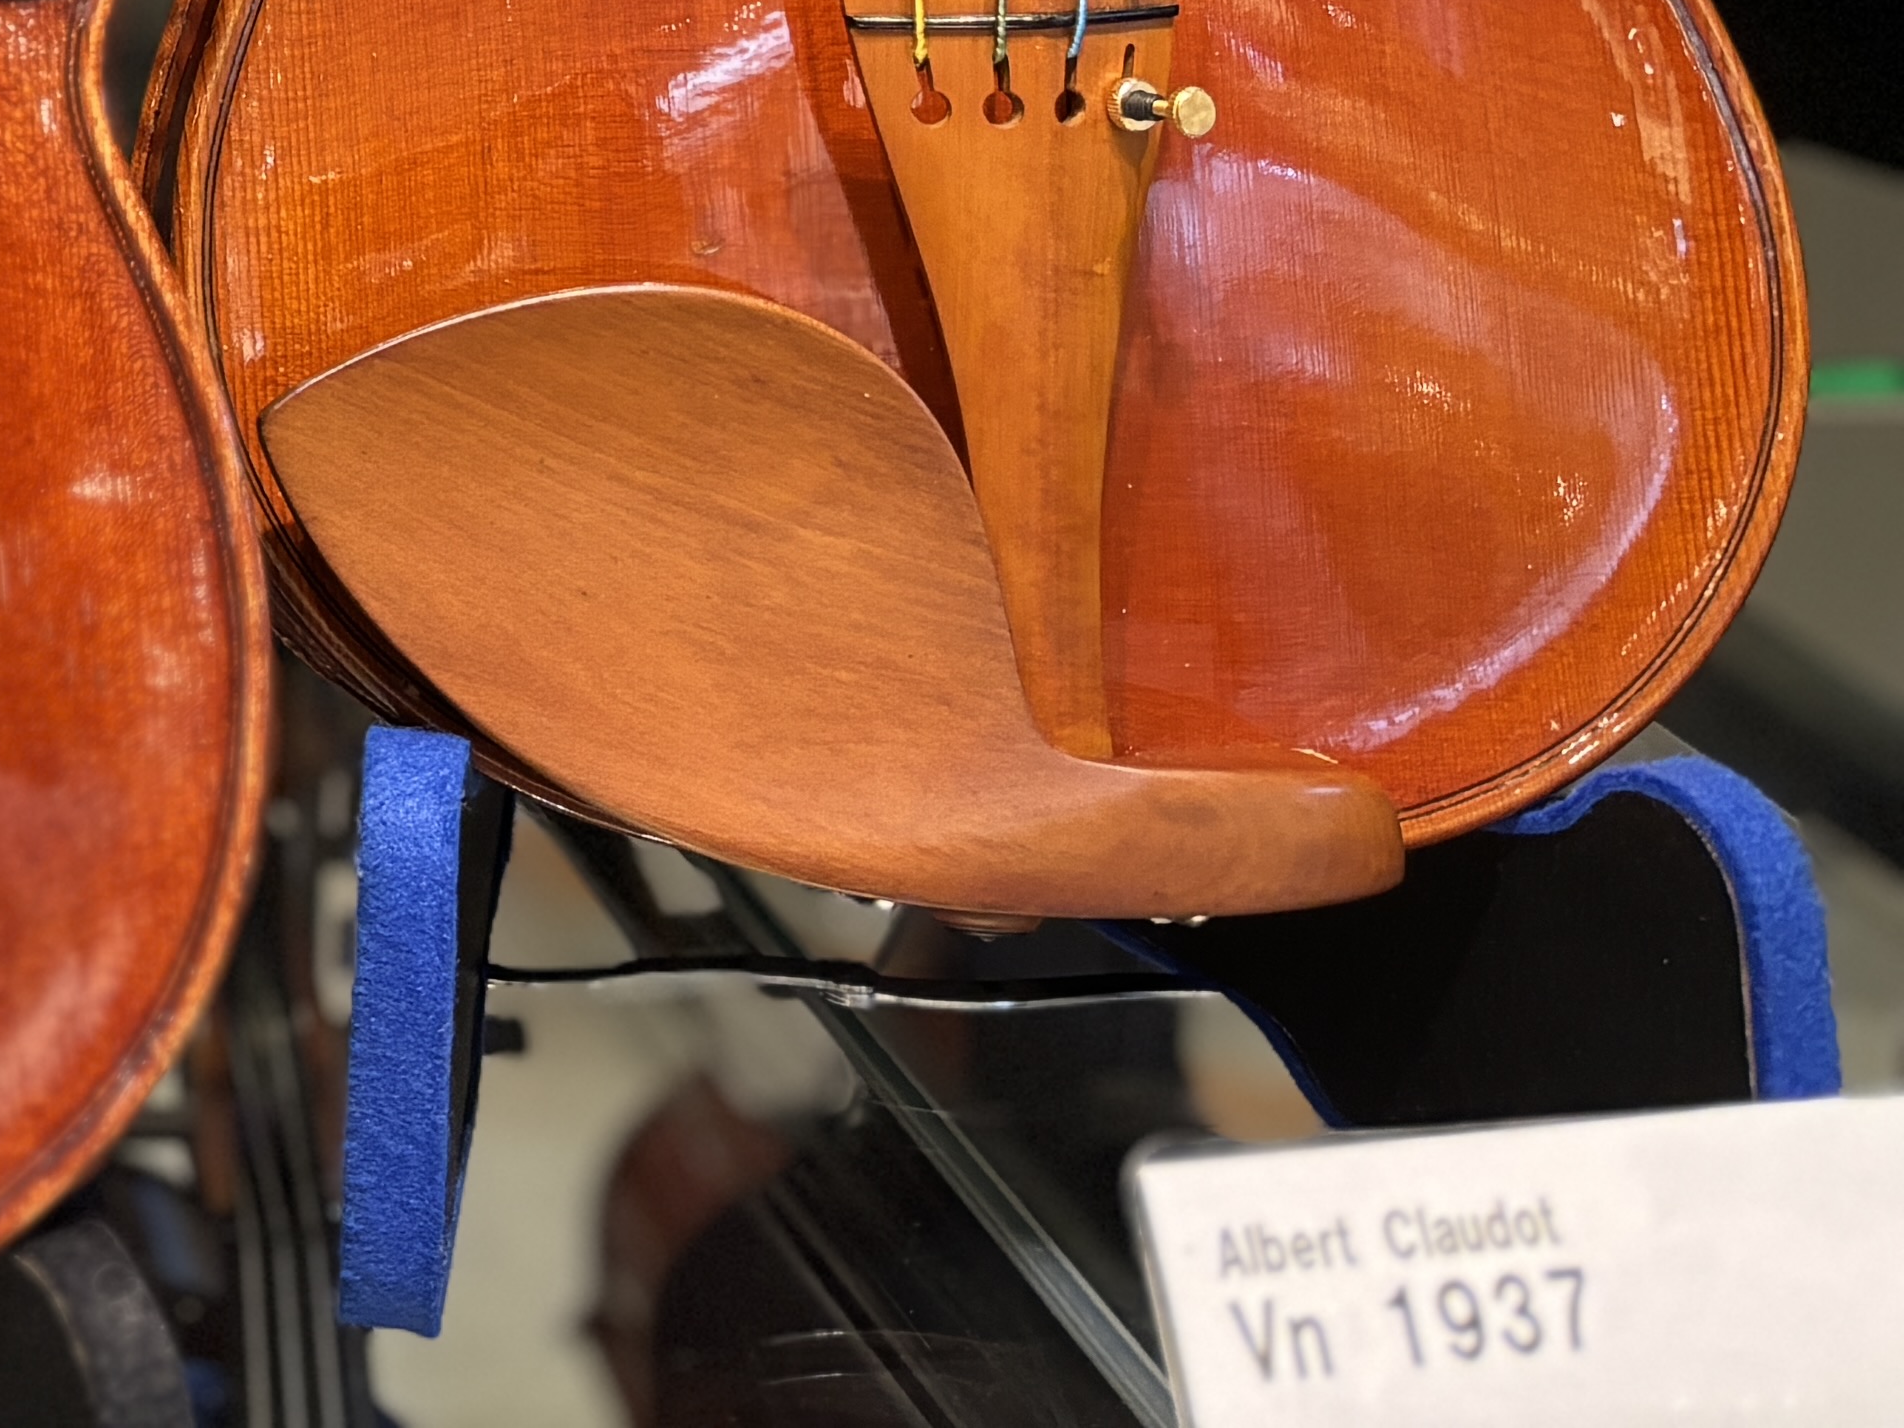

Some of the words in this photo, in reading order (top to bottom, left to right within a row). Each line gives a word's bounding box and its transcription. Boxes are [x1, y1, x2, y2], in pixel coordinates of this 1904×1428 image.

[1219, 1217, 1359, 1279] Albert
[1382, 1196, 1563, 1262] Claudot
[1227, 1296, 1336, 1384] Vn
[1384, 1264, 1587, 1370] 1937
